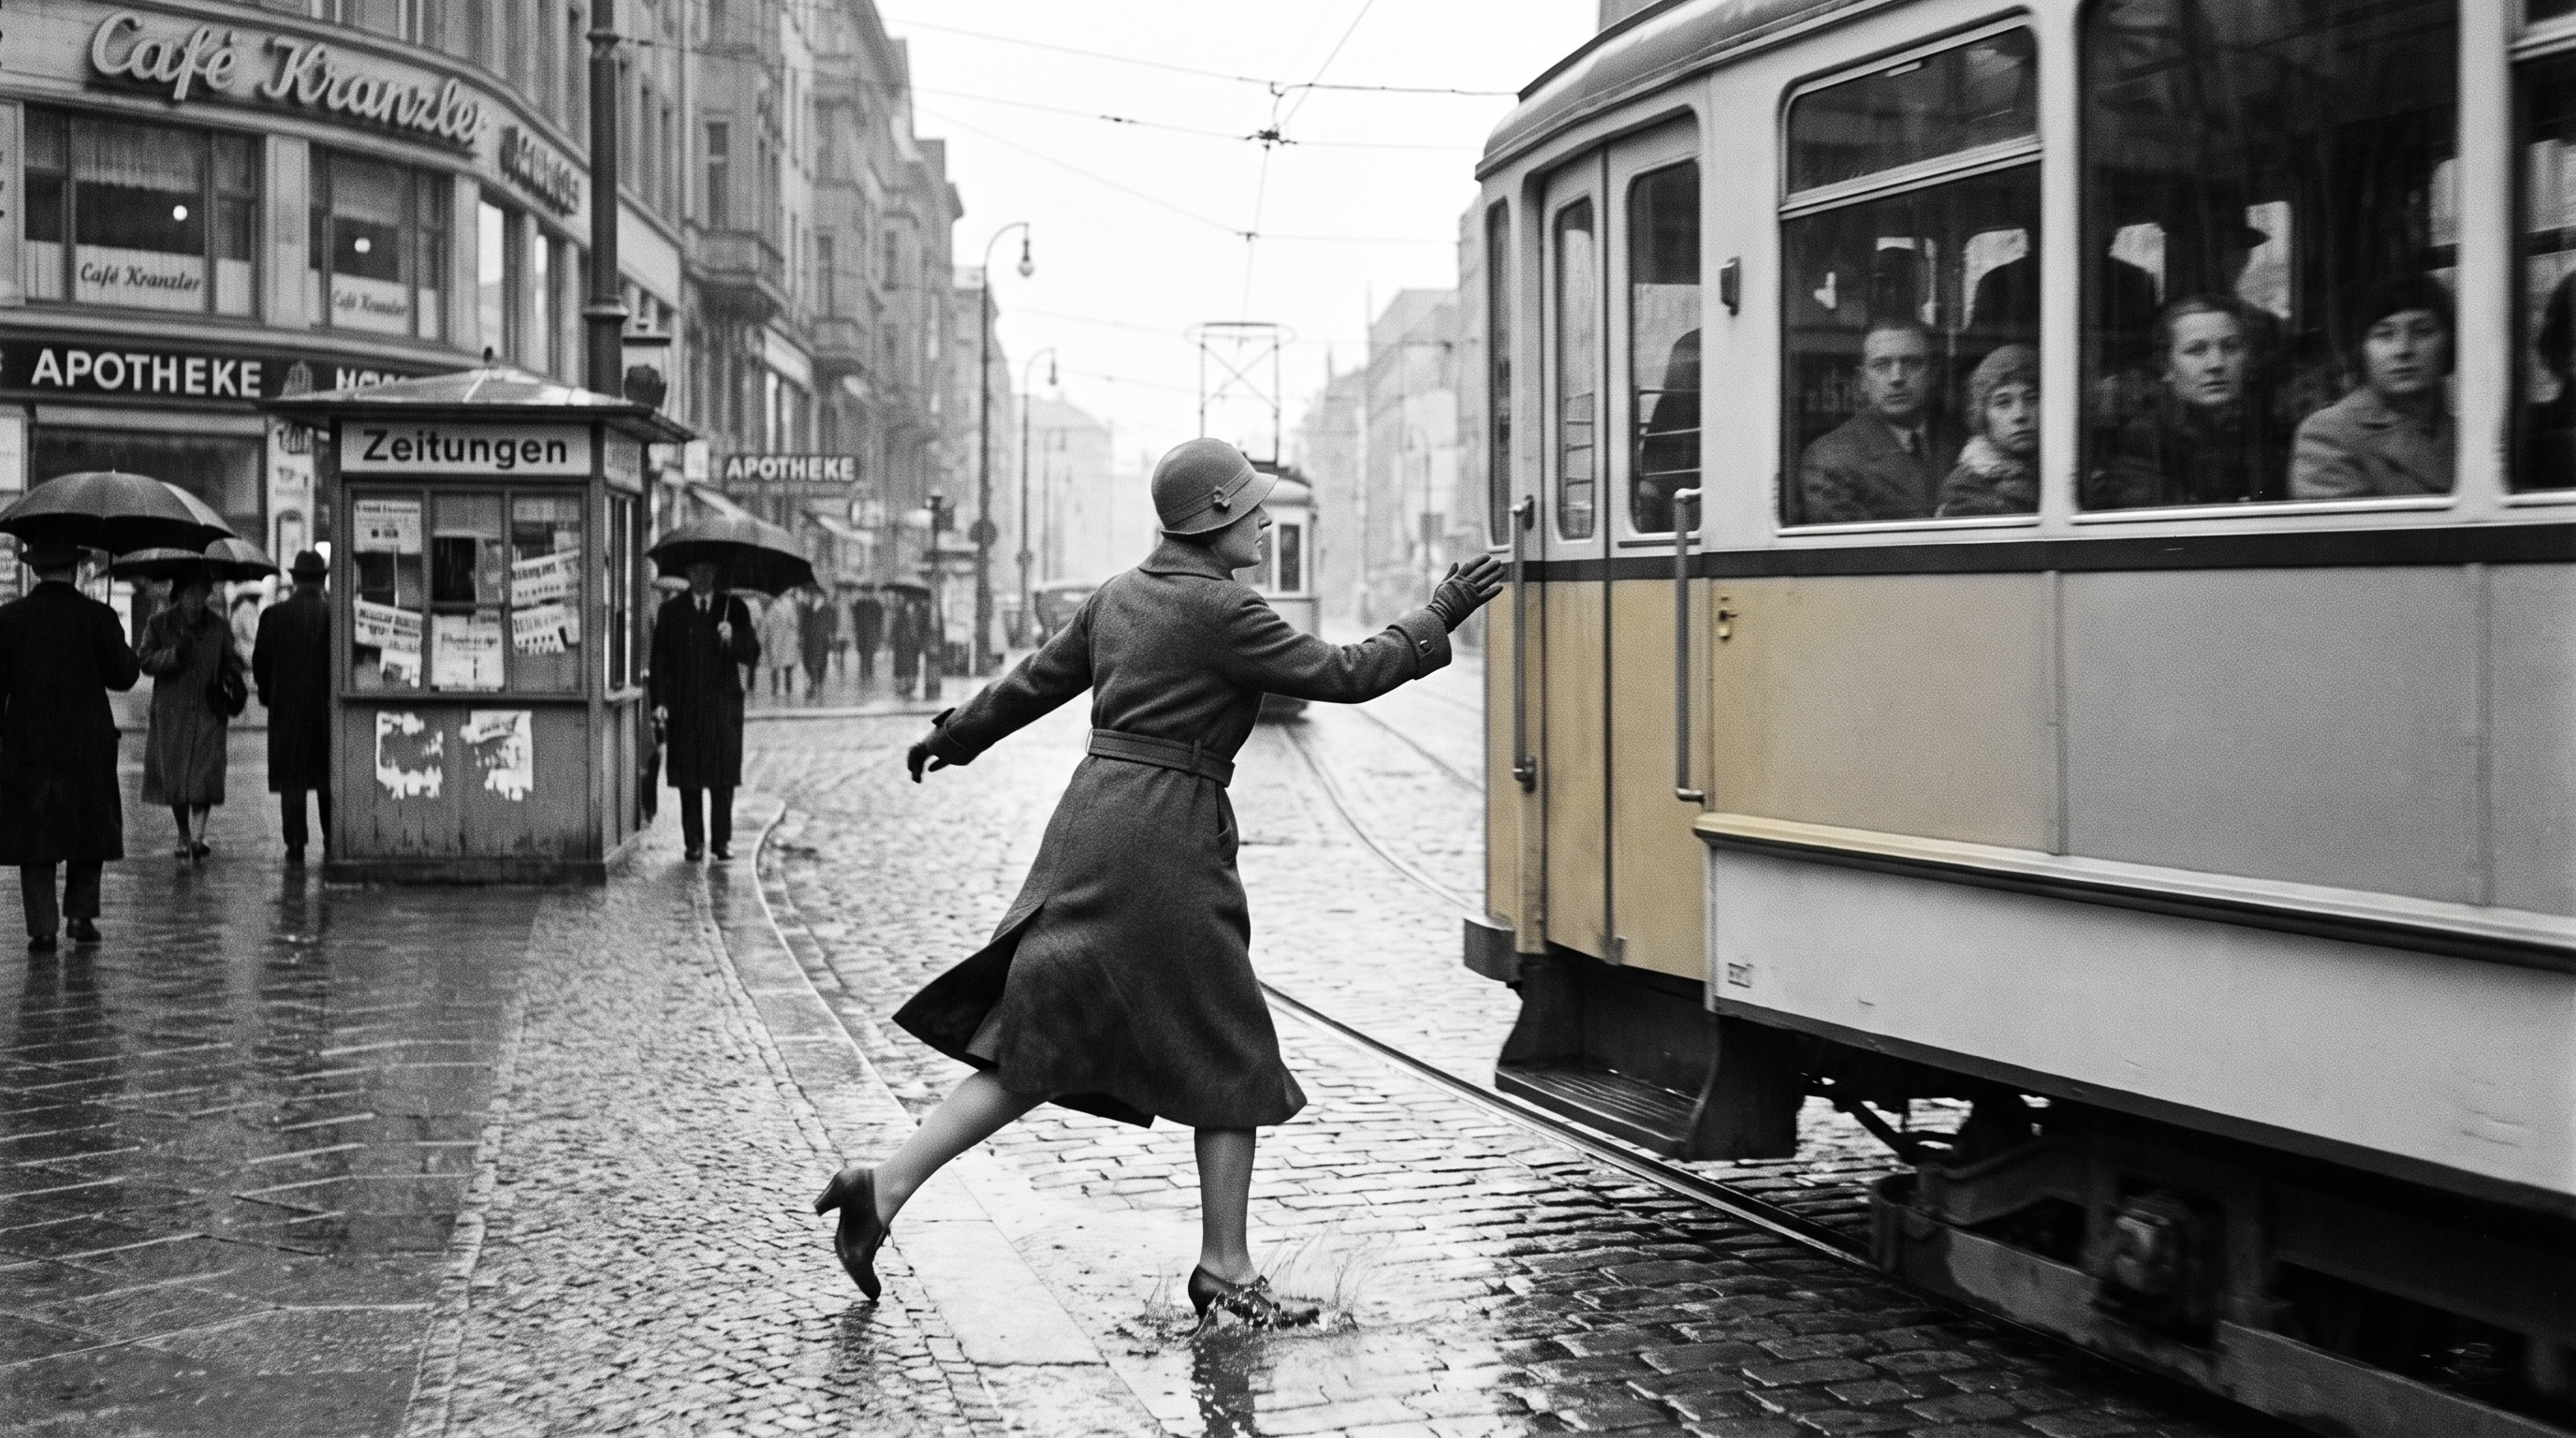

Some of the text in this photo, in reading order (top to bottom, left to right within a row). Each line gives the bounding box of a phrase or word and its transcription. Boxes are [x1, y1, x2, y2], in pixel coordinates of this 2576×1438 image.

[92, 10, 237, 101] Café
[80, 262, 201, 291] Café Kranzler
[31, 348, 262, 398] APOTHEKE
[363, 428, 567, 470] Zeitungen
[726, 456, 856, 481] APOTHEKE
